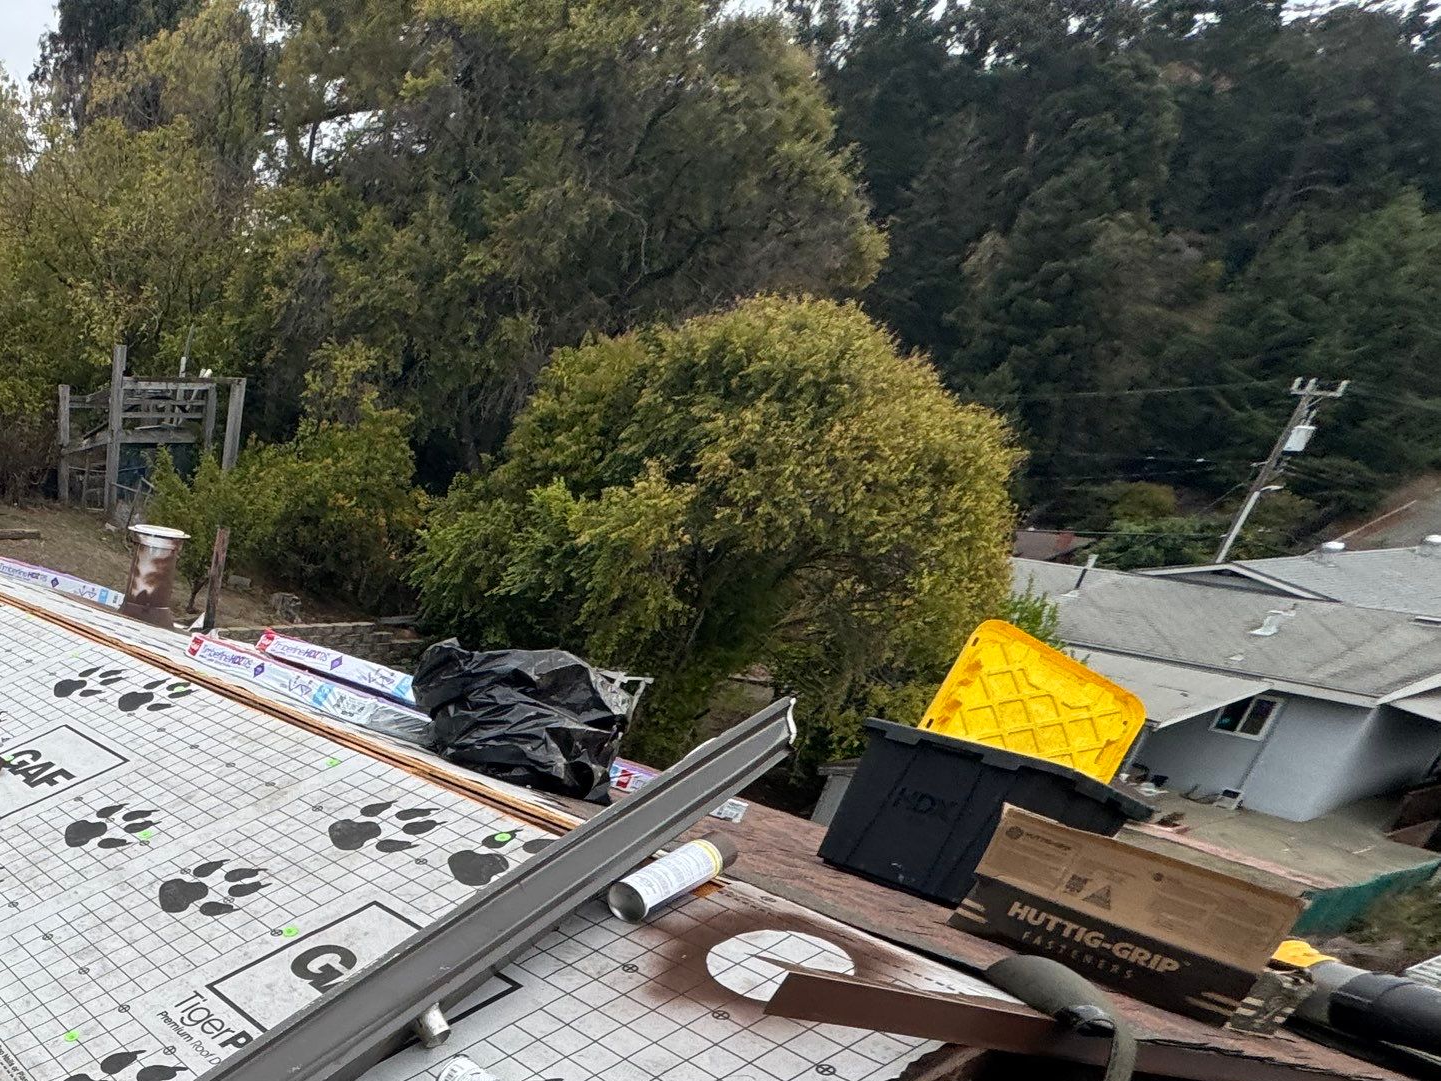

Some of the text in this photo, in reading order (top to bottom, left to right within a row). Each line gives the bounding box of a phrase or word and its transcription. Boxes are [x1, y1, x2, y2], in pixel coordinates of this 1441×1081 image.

[2, 749, 77, 788] GAF
[1007, 901, 1180, 973] HUTTIG-GRIP
[1021, 930, 1134, 979] FASTENERS
[156, 1010, 216, 1059] Premium Roof
[174, 989, 254, 1049] TigerP
[2, 1054, 15, 1068] Nails
[11, 1065, 21, 1076] or
